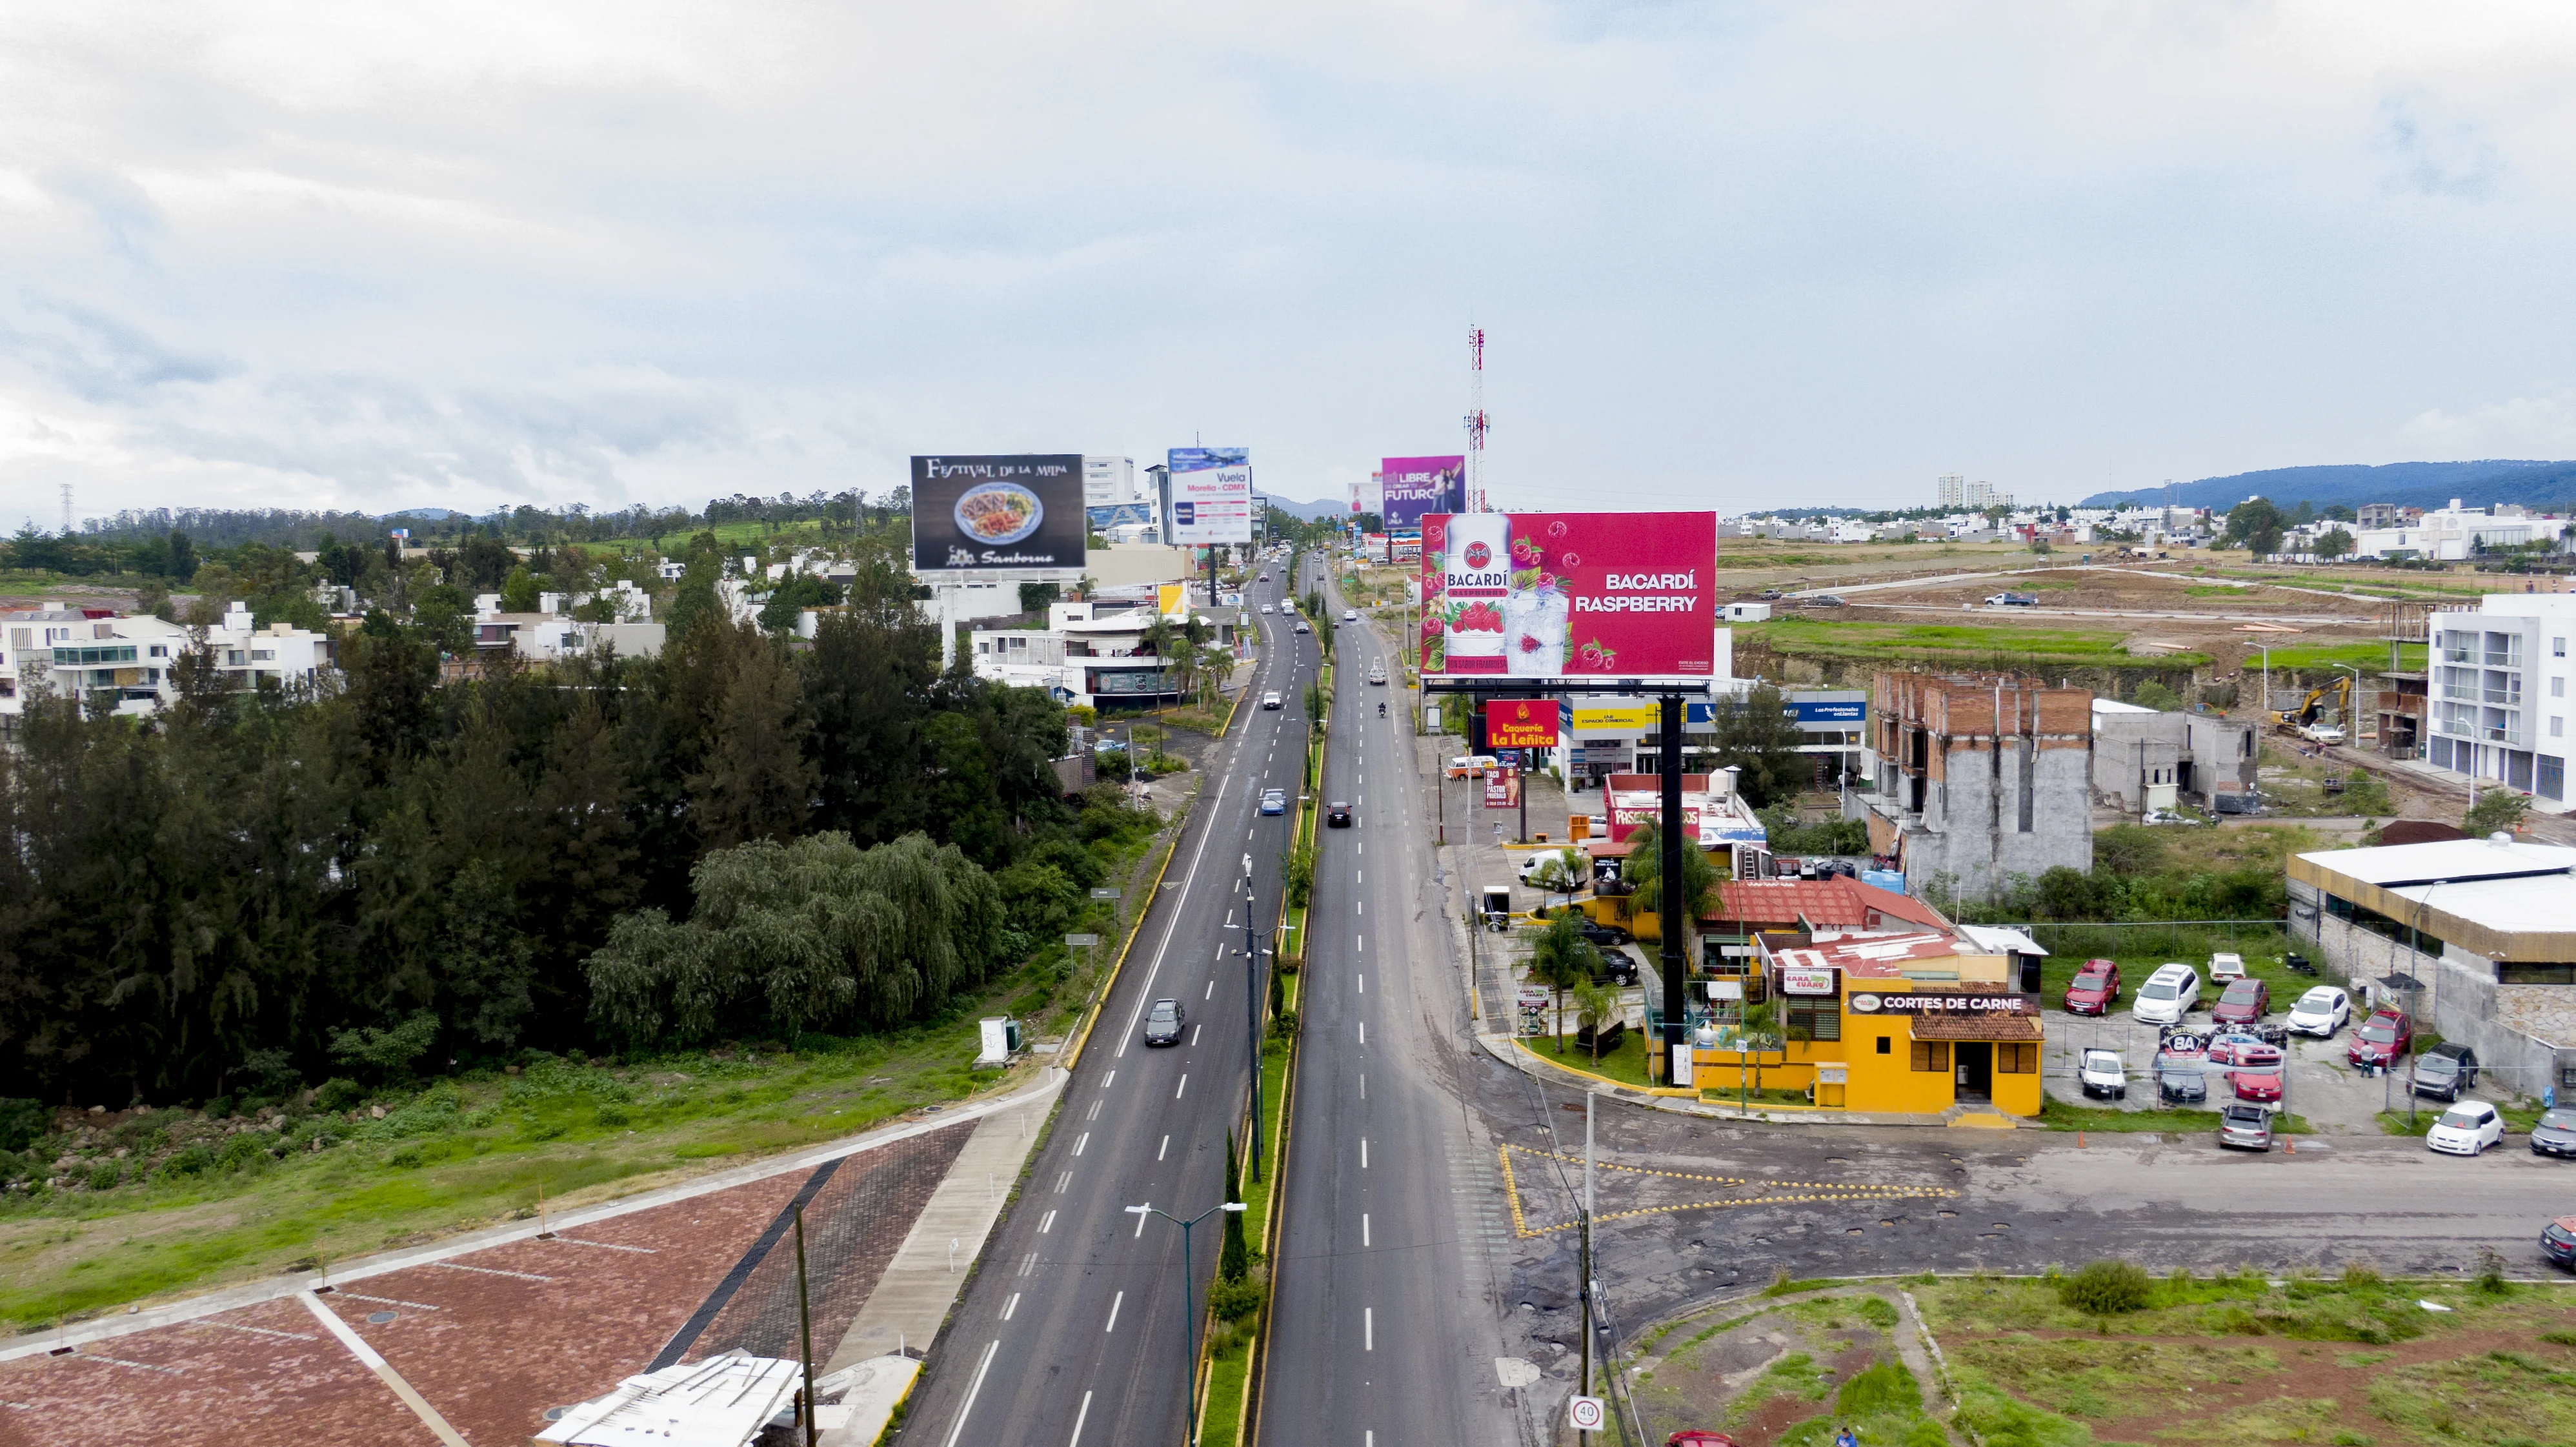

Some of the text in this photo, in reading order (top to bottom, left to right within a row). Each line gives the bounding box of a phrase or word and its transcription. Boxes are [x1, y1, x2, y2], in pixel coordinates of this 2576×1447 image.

[926, 458, 1067, 478] FESTIVAL DE LA MILPA
[1217, 472, 1245, 482] Vuela
[1399, 472, 1431, 483] LIBRE
[1385, 489, 1435, 501] FUTURO
[981, 551, 1054, 563] Sanborns
[1448, 570, 1507, 586] BACARDÍ
[1606, 569, 1695, 589] BACARDÍ
[1575, 596, 1697, 612] RASPBERRY
[1447, 660, 1507, 669] RON SABOR FRAMBUESA
[1492, 733, 1554, 745] La Leñita
[1884, 997, 2022, 1009] CORTES DE CARNE
[2174, 1037, 2195, 1050] 8A
[1580, 1406, 1594, 1416] 40
